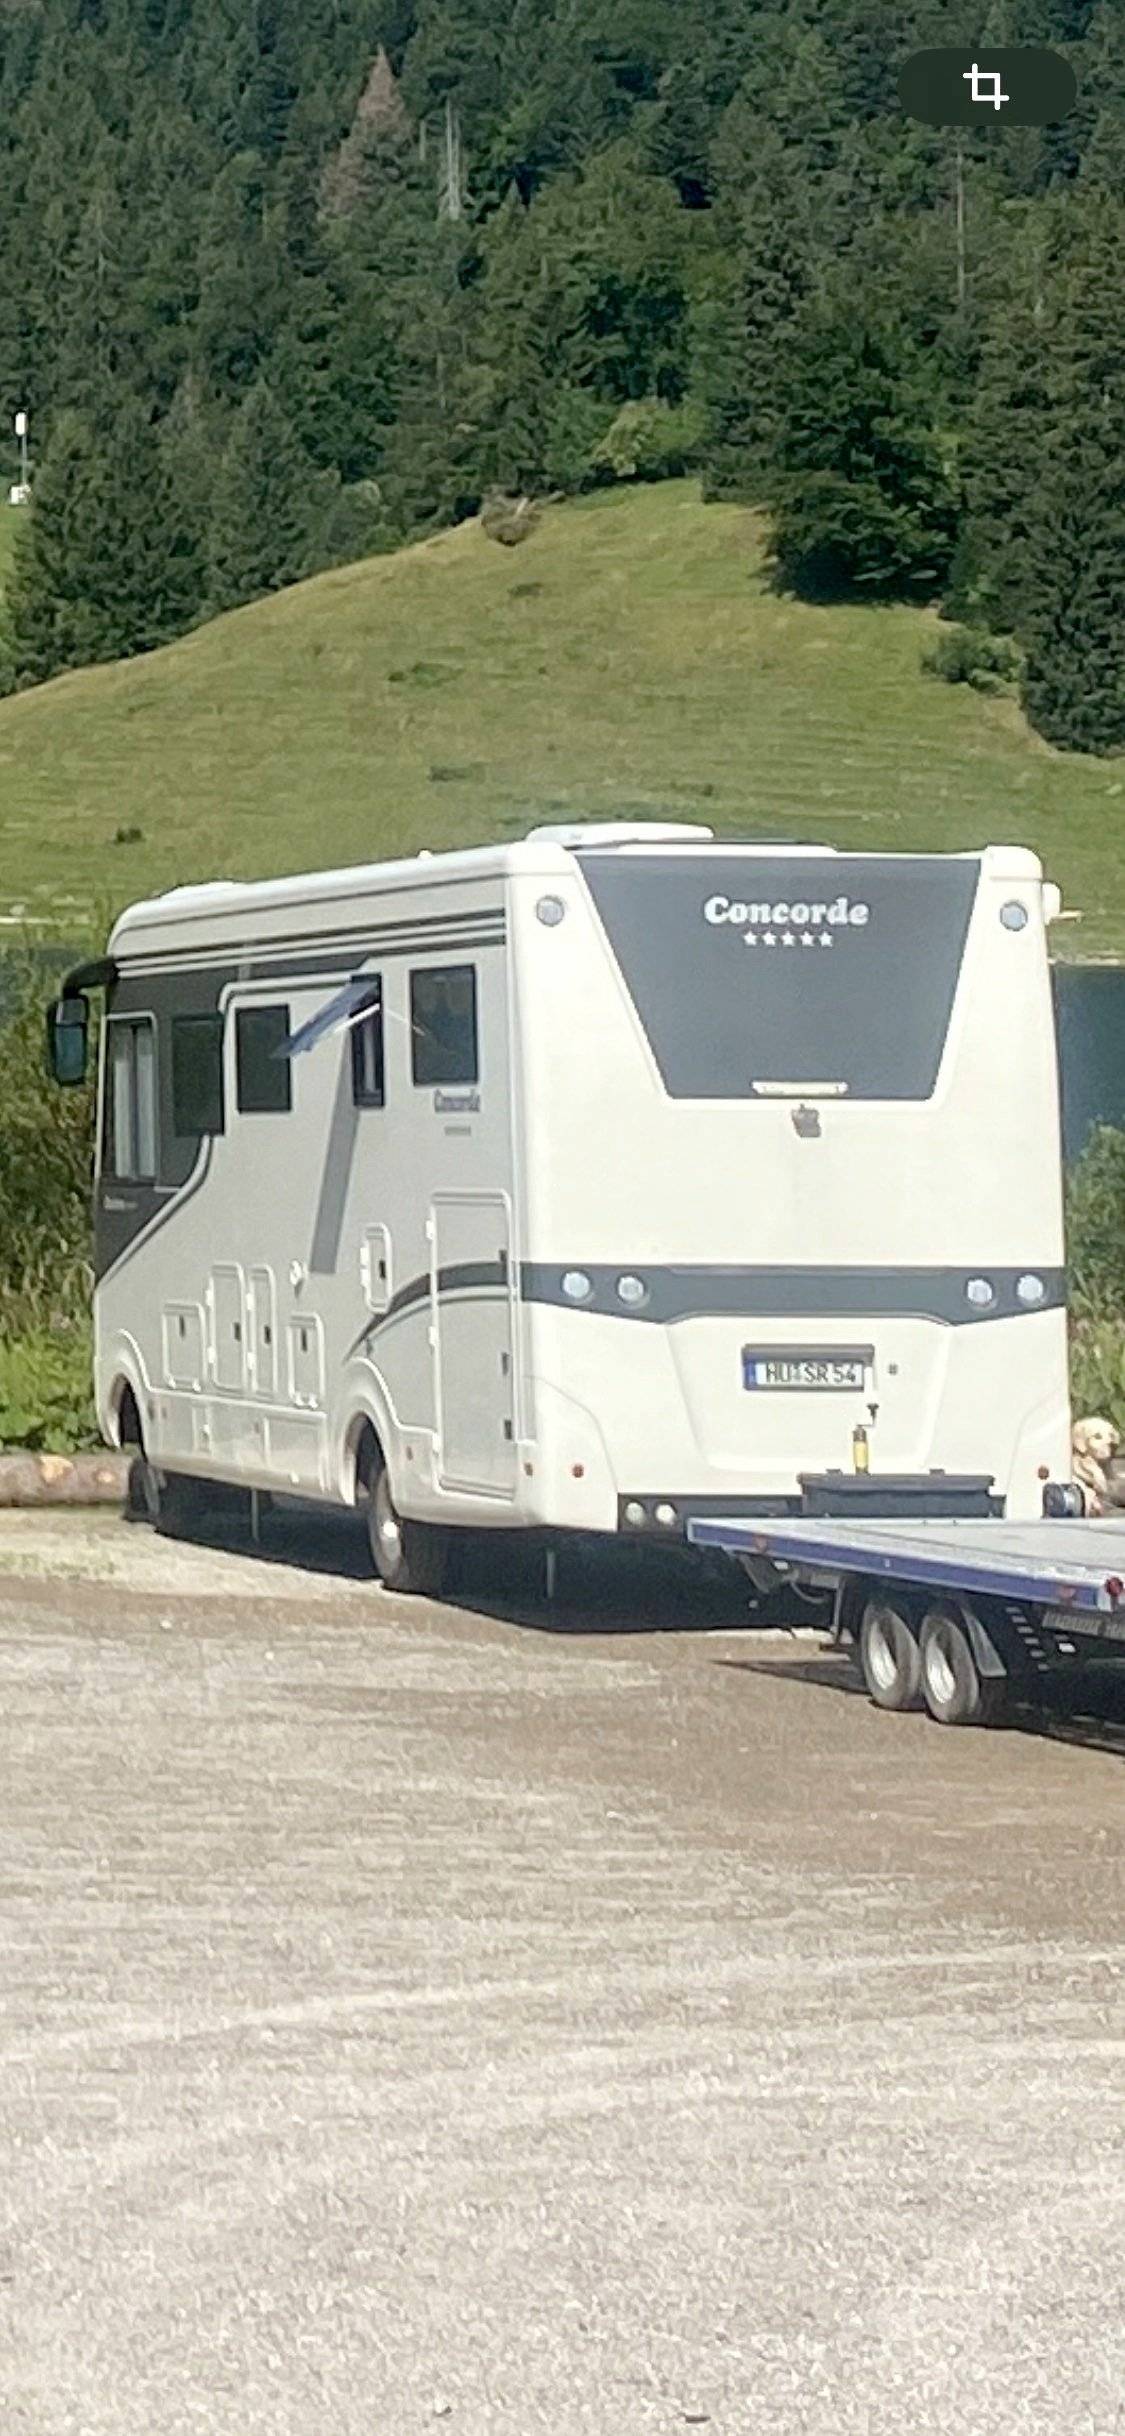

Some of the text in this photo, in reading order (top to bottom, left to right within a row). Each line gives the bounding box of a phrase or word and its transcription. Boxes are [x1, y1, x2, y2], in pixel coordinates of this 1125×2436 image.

[704, 896, 870, 926] Concorde
[766, 1361, 791, 1383] HU
[804, 1361, 829, 1383] SR
